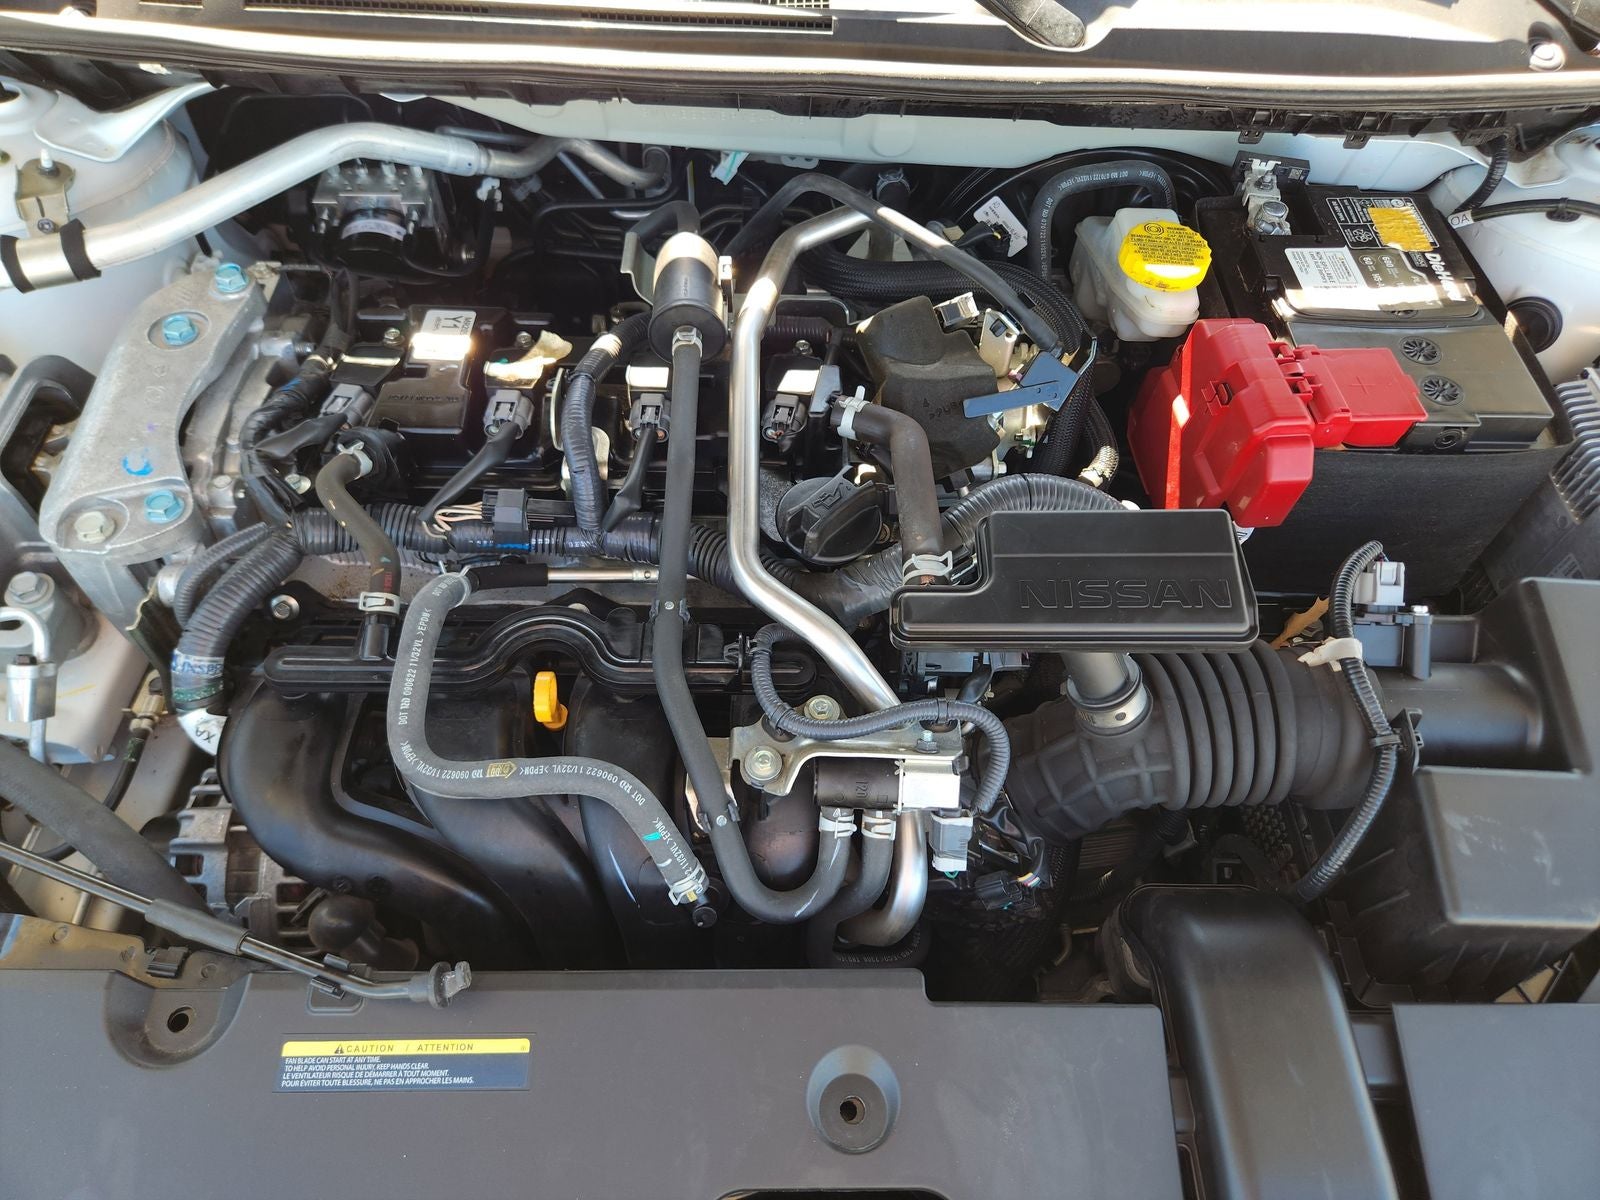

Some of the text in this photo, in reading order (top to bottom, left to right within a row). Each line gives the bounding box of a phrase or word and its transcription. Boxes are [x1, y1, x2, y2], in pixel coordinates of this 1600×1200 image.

[1019, 578, 1232, 609] NISSAN
[403, 669, 417, 696] 090622
[399, 712, 408, 725] DOT
[442, 769, 470, 780] 090622
[519, 766, 549, 776] >EPDM<
[586, 766, 618, 784] 090622
[631, 792, 646, 806] DOT
